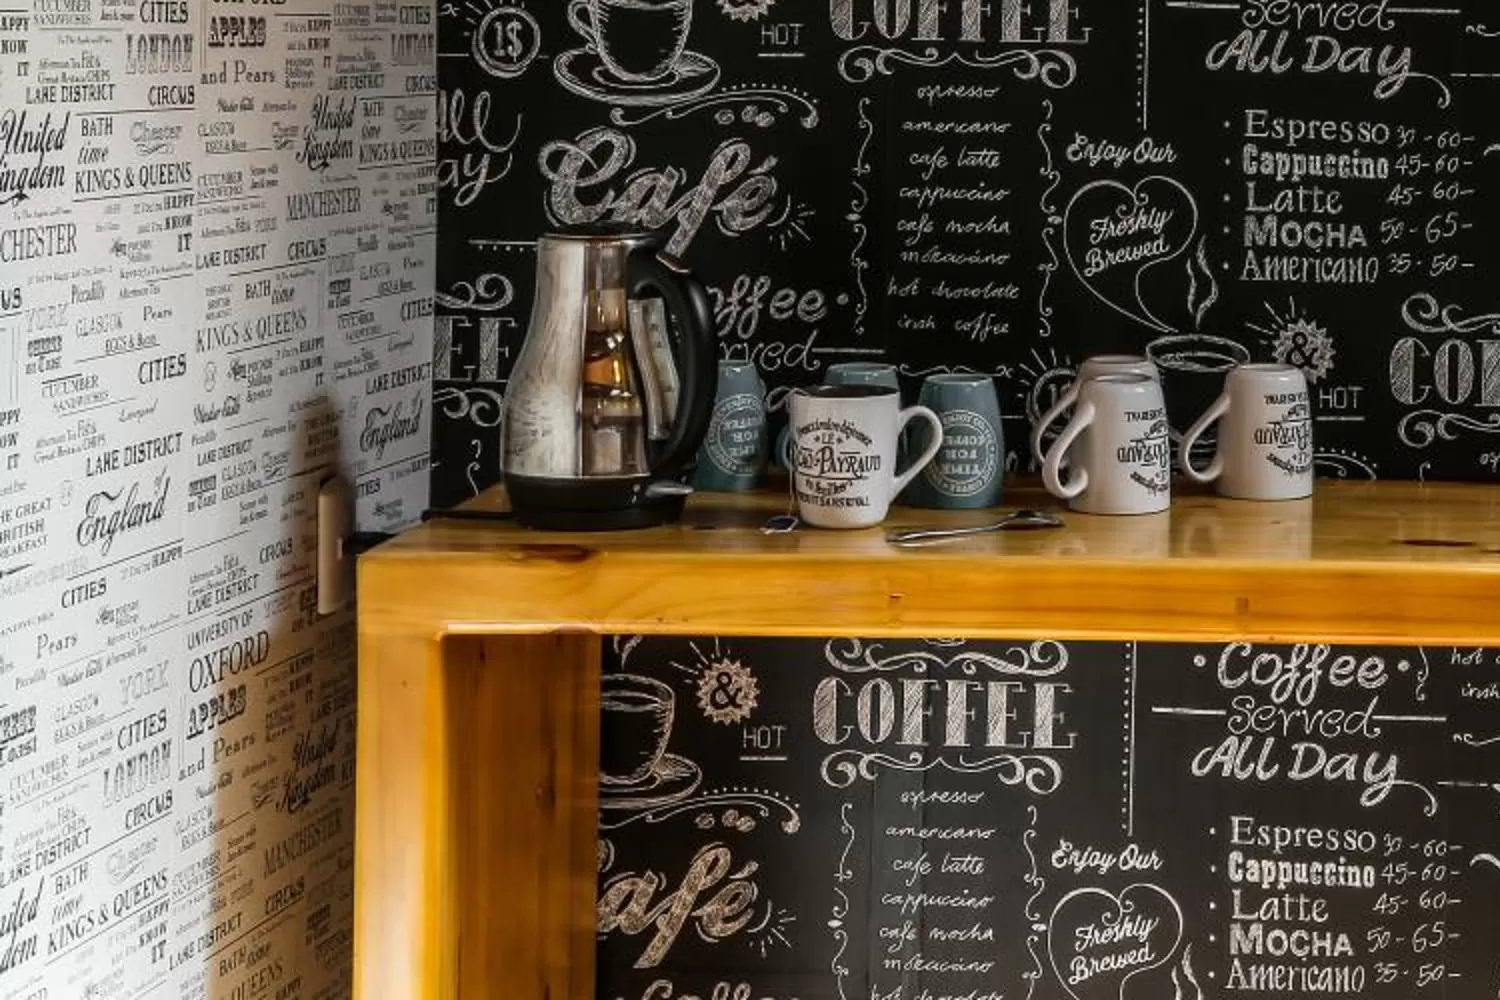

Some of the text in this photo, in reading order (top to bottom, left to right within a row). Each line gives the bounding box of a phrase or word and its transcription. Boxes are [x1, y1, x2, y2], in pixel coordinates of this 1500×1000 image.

[139, 0, 189, 24] CITIES
[759, 23, 804, 47] HOT
[233, 59, 276, 84] Pears
[1205, 30, 1414, 100] All Day
[25, 83, 115, 105] LAKE DISTRICT
[148, 84, 195, 107] CIRCUS
[81, 117, 114, 136] BATH
[1243, 108, 1390, 146] Espresso
[74, 167, 120, 194] KINGS
[139, 161, 192, 187] QUEENS
[287, 238, 327, 261] CIRCUS
[1239, 248, 1380, 284] Americano
[138, 352, 187, 385] CITIES
[85, 432, 183, 478] LAKE DISTRICT
[76, 477, 169, 558] England
[60, 578, 107, 610] CITIES
[188, 630, 271, 695] OXFORD
[812, 675, 1077, 749] COFFEE
[1225, 696, 1382, 738] Served
[125, 792, 174, 831] CIRCUS
[1226, 852, 1376, 891] Cappuccino
[1229, 926, 1354, 957] MOCHA
